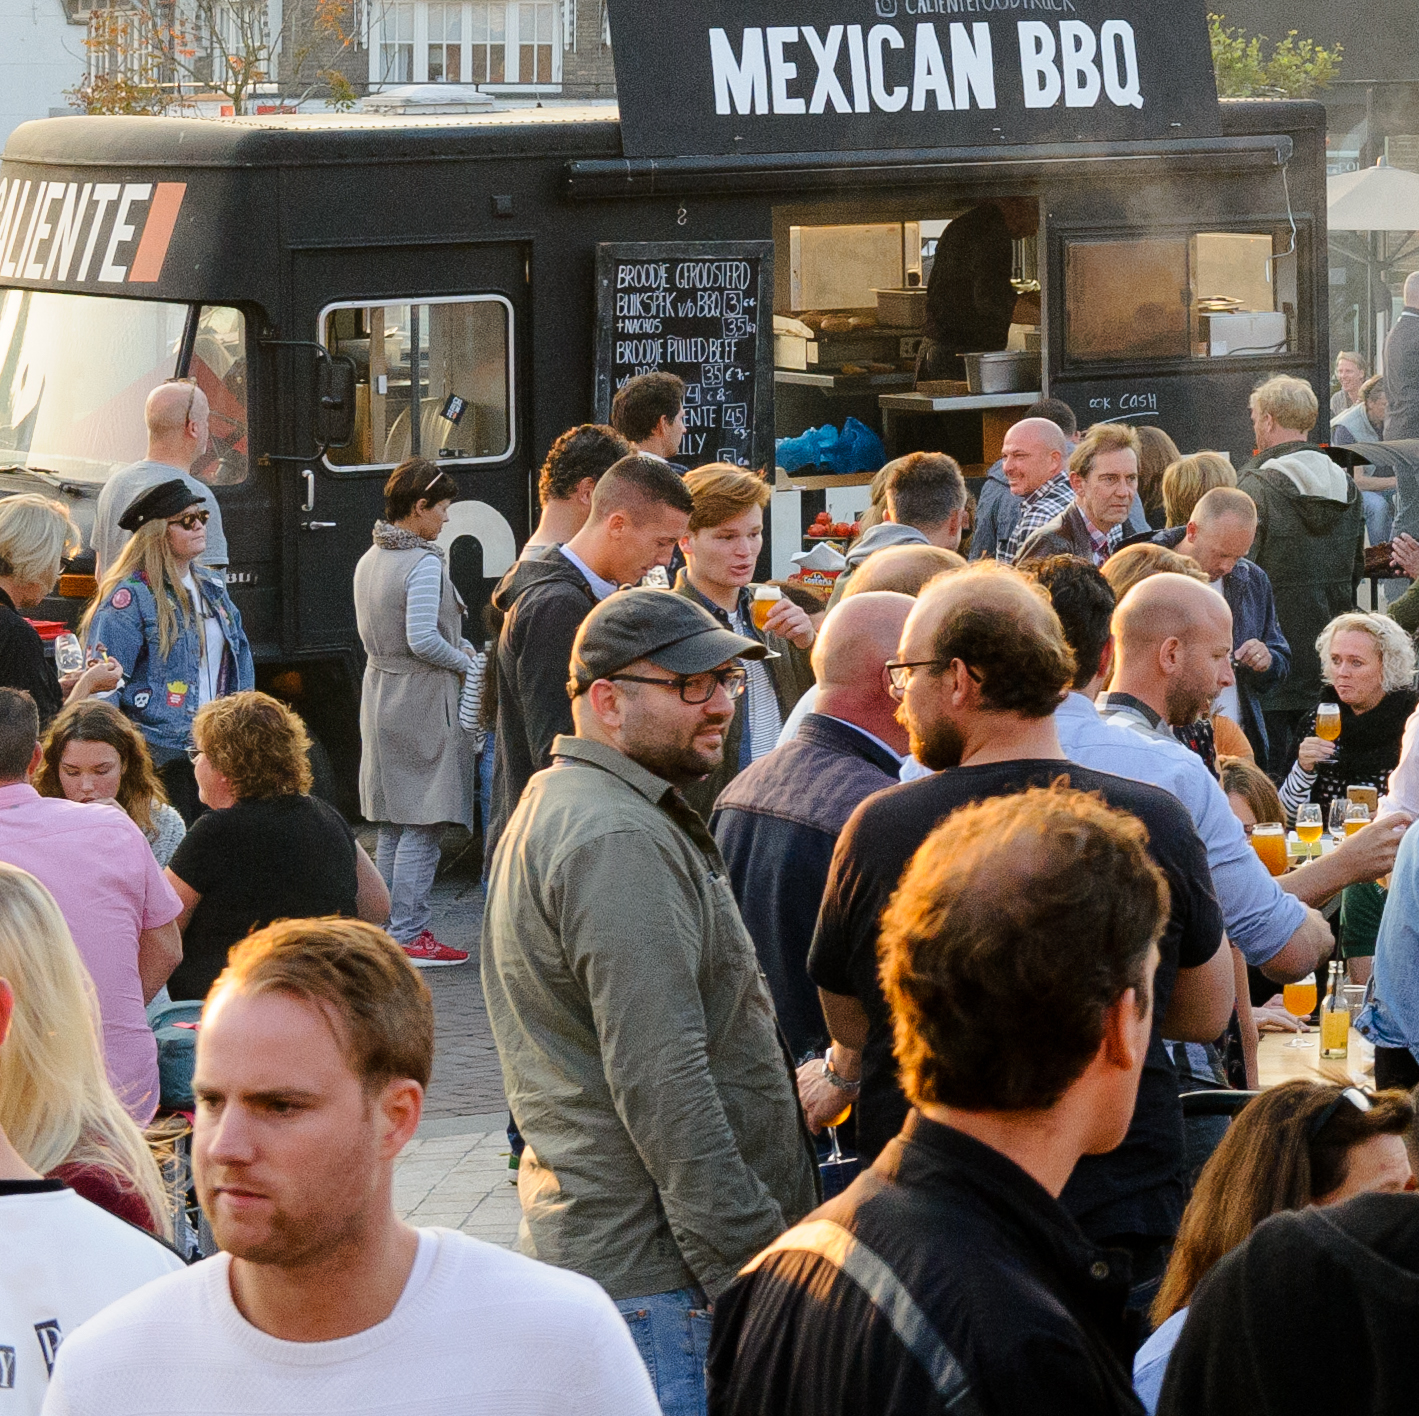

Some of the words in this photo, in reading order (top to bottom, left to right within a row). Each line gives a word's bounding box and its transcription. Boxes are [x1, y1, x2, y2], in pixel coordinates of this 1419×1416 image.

[709, 21, 996, 115] MEXICAN
[1017, 19, 1144, 110] BBQ
[0, 178, 153, 283] ALIENTE
[675, 262, 751, 290] GEROOSTERD
[696, 291, 721, 318] BBQ
[726, 293, 740, 316] 3
[709, 338, 739, 363] BEEF
[683, 406, 718, 428] ENTE
[677, 433, 707, 456] LLY
